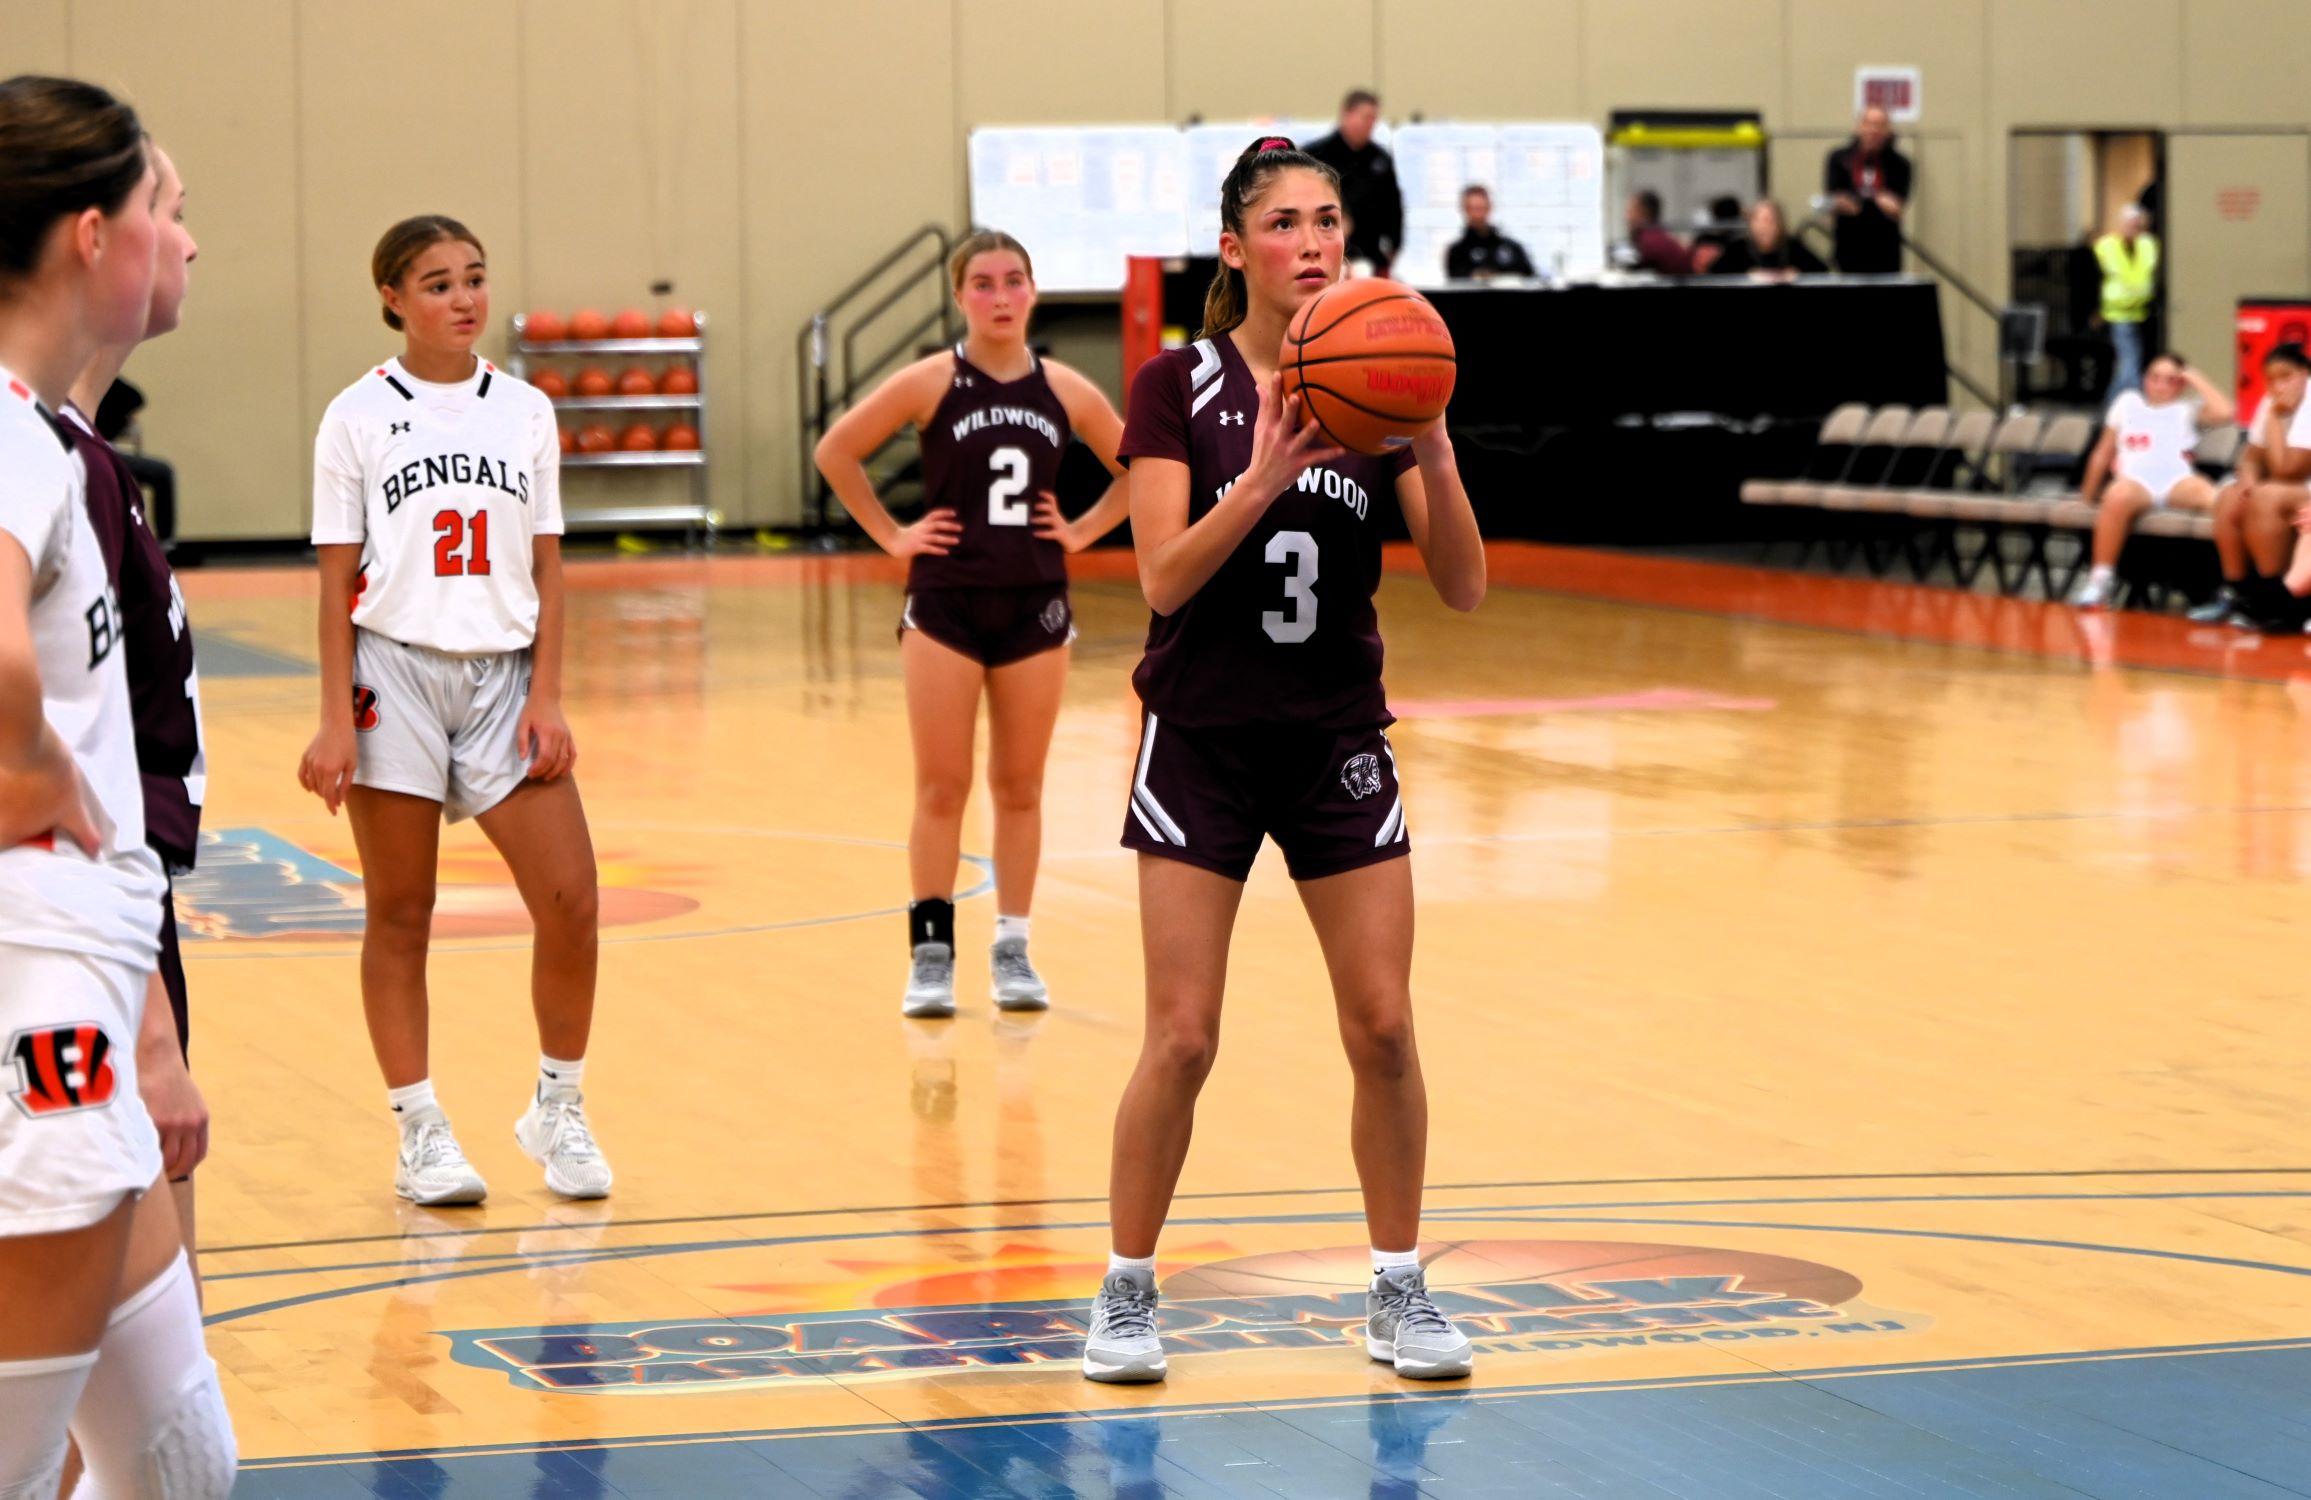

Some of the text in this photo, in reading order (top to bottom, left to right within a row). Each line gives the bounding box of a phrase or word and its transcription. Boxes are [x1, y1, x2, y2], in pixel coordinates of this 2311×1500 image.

[952, 406, 1059, 449] WILDWOOD
[382, 453, 529, 515] BENGALS
[987, 447, 1029, 526] 2
[1215, 467, 1368, 521] WWOOD
[433, 509, 491, 577] 21
[1262, 531, 1319, 643] 3
[1341, 1298, 1849, 1345] LASSIC
[1822, 1320, 1905, 1334] NJ
